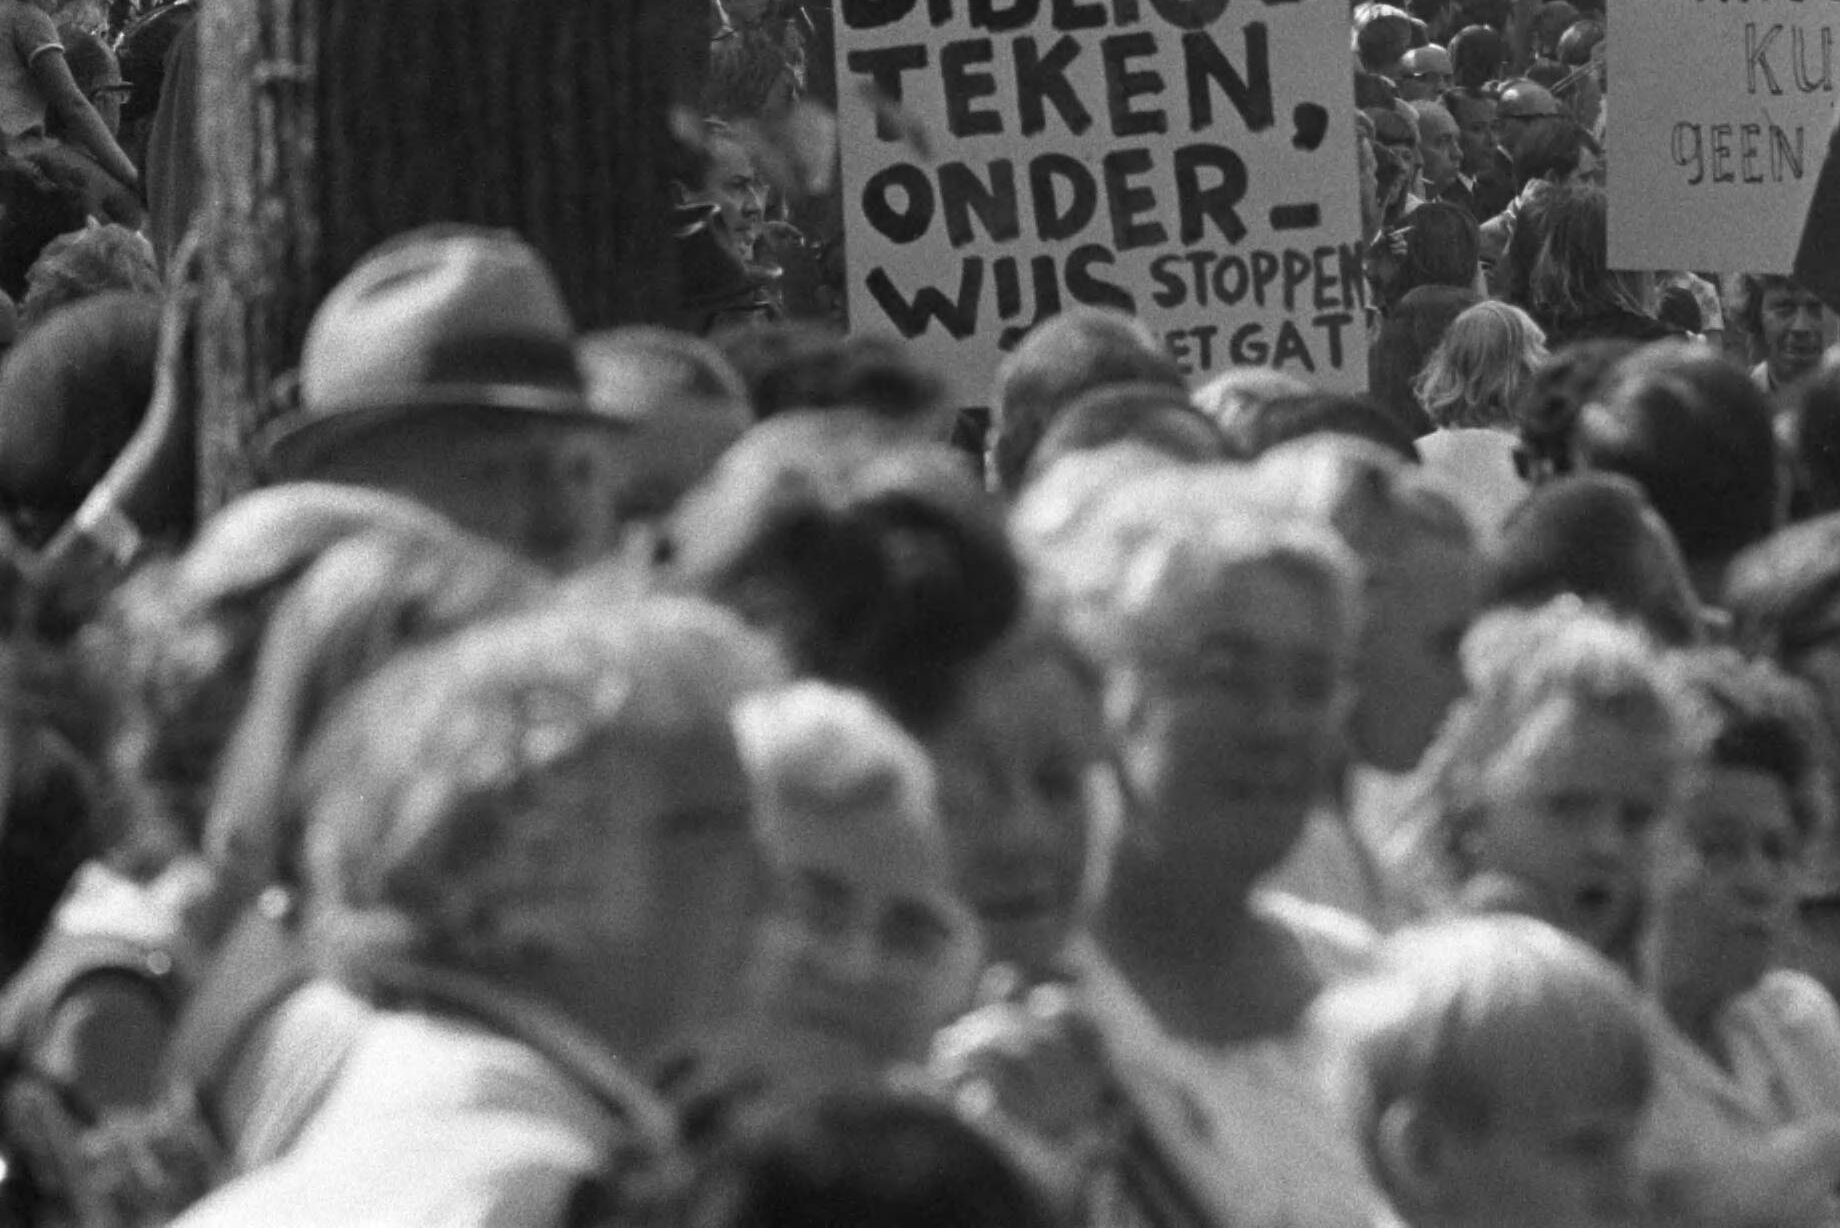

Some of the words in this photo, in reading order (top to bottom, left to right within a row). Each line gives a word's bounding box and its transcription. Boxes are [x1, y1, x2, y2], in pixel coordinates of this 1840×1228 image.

[847, 21, 1329, 152] TEKEN,
[861, 142, 1322, 250] ONDER-
[1149, 240, 1367, 312] STOPPEN
[1163, 324, 1219, 375] ET
[1229, 313, 1354, 373] GAT
